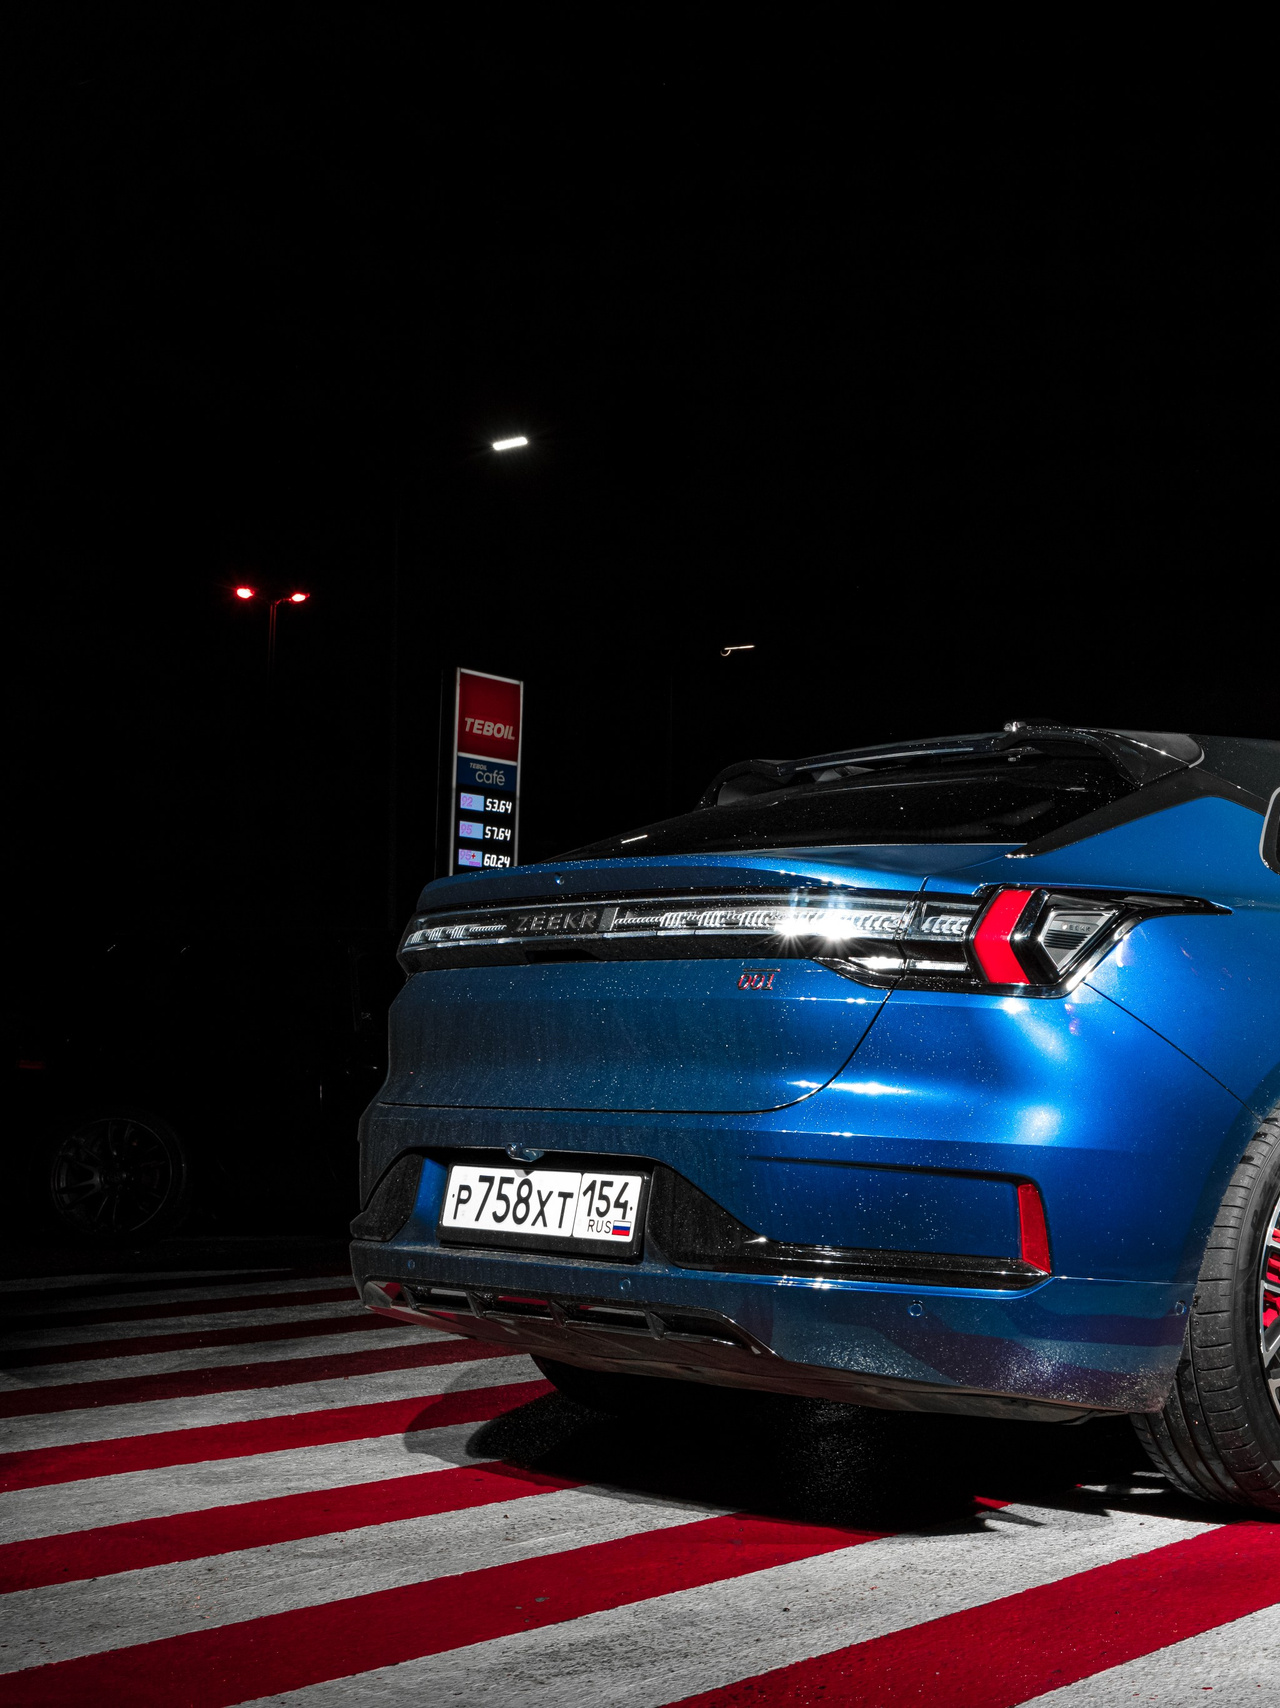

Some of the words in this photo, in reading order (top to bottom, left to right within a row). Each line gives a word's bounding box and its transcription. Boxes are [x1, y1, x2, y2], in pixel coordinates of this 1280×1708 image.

[464, 717, 516, 741] TEBOIL
[469, 762, 488, 771] TEBOIL
[475, 770, 505, 787] café
[461, 795, 473, 807] 92
[485, 798, 512, 814] 53.64
[460, 823, 472, 836] 95
[484, 826, 511, 841] 57.64
[483, 853, 511, 868] 60.24
[516, 910, 598, 932] ZEEKR
[737, 973, 776, 991] 001
[582, 1179, 630, 1220] 154
[586, 1219, 612, 1234] RUS
